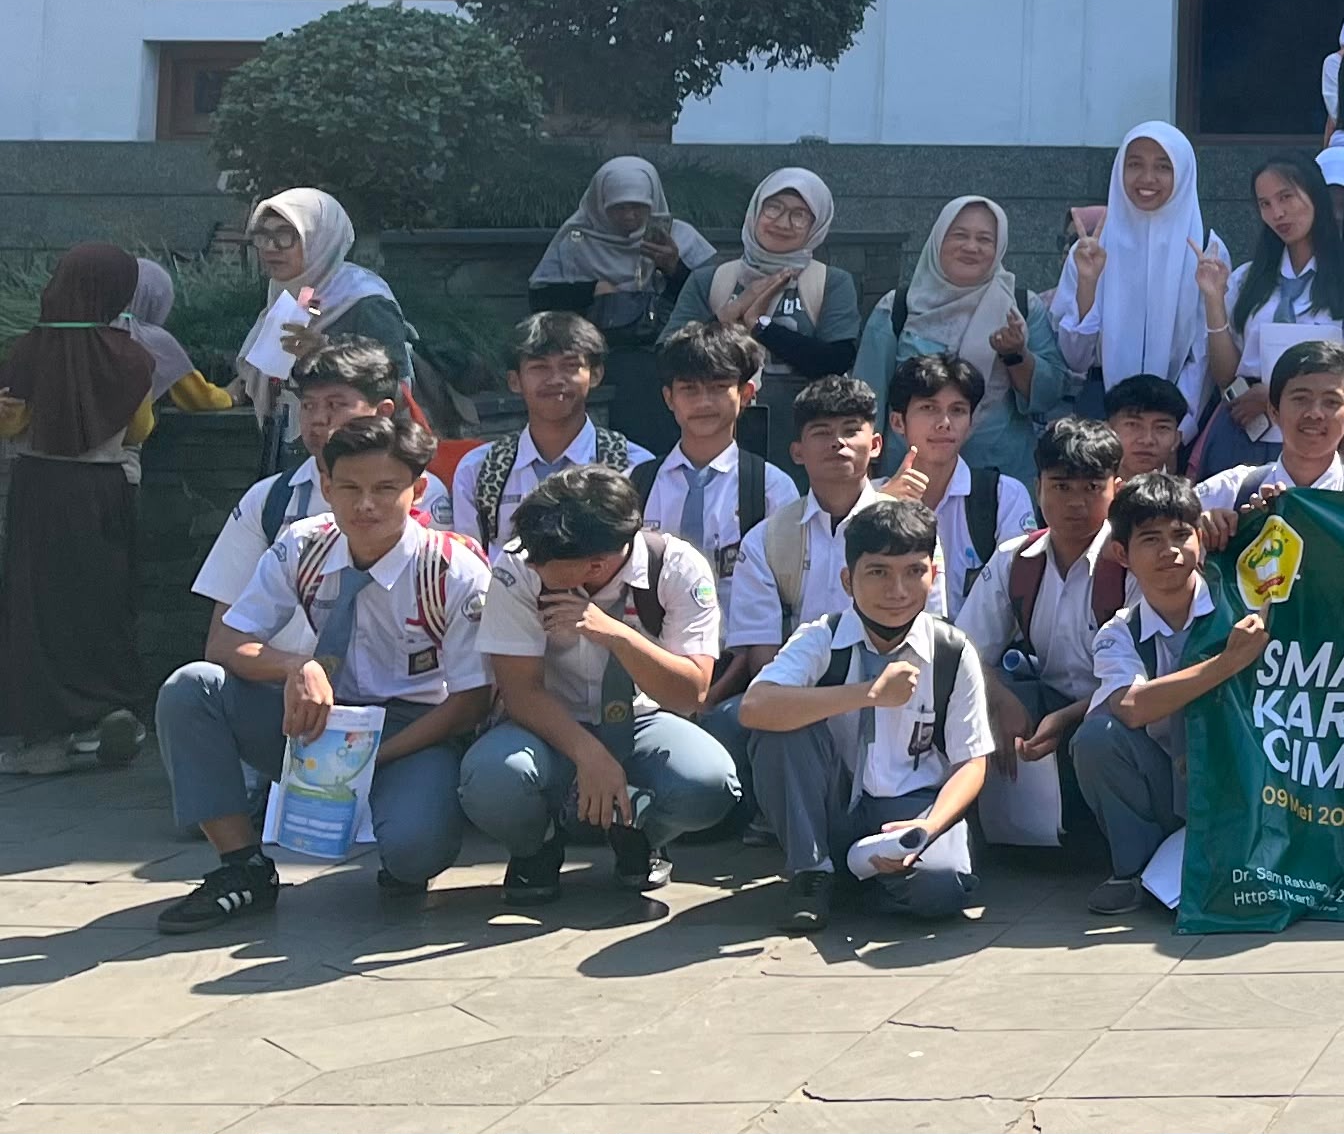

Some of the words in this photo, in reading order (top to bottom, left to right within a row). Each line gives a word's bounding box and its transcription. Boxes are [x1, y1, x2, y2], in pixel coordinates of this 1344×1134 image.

[1262, 785, 1289, 808] 09
[1232, 868, 1253, 884] Dr.
[1256, 867, 1283, 885] Sam
